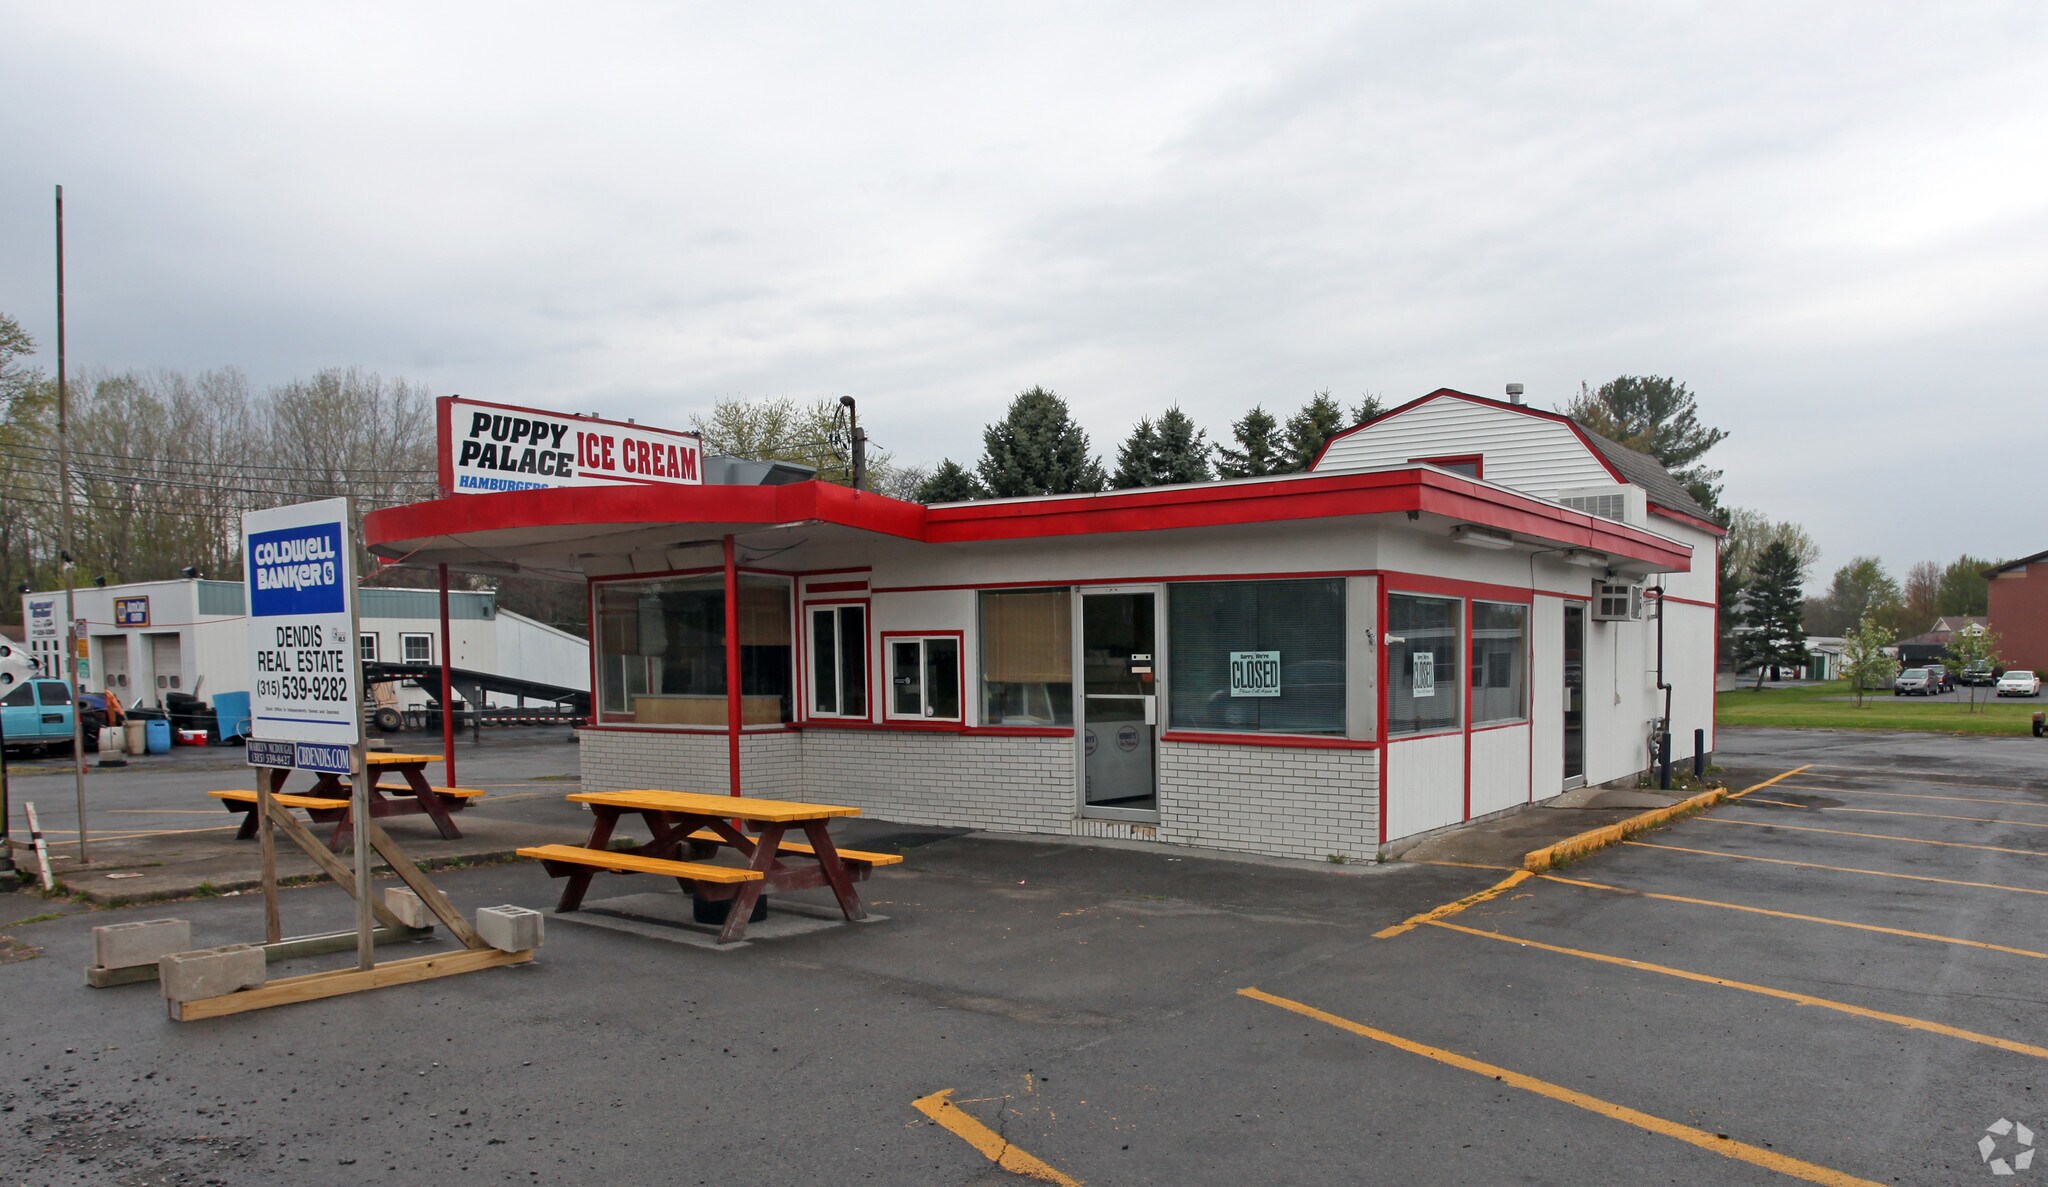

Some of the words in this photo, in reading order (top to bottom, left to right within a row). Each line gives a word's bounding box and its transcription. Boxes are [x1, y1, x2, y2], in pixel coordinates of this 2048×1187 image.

[469, 412, 568, 449] PUPPY
[459, 440, 575, 478] PALACE
[577, 432, 615, 470] ICE
[622, 438, 697, 481] CREAM
[255, 536, 335, 565] COLDWELL
[257, 563, 322, 591] BANKER
[276, 625, 323, 648] DENDIS
[257, 650, 291, 672] REAL
[297, 650, 345, 672] ESTATE
[1232, 660, 1278, 688] CLOSED
[1414, 661, 1433, 689] CLOSED
[257, 680, 280, 699] (315)
[282, 676, 348, 701] 539-9282
[297, 746, 349, 769] CBDENDIS.COM
